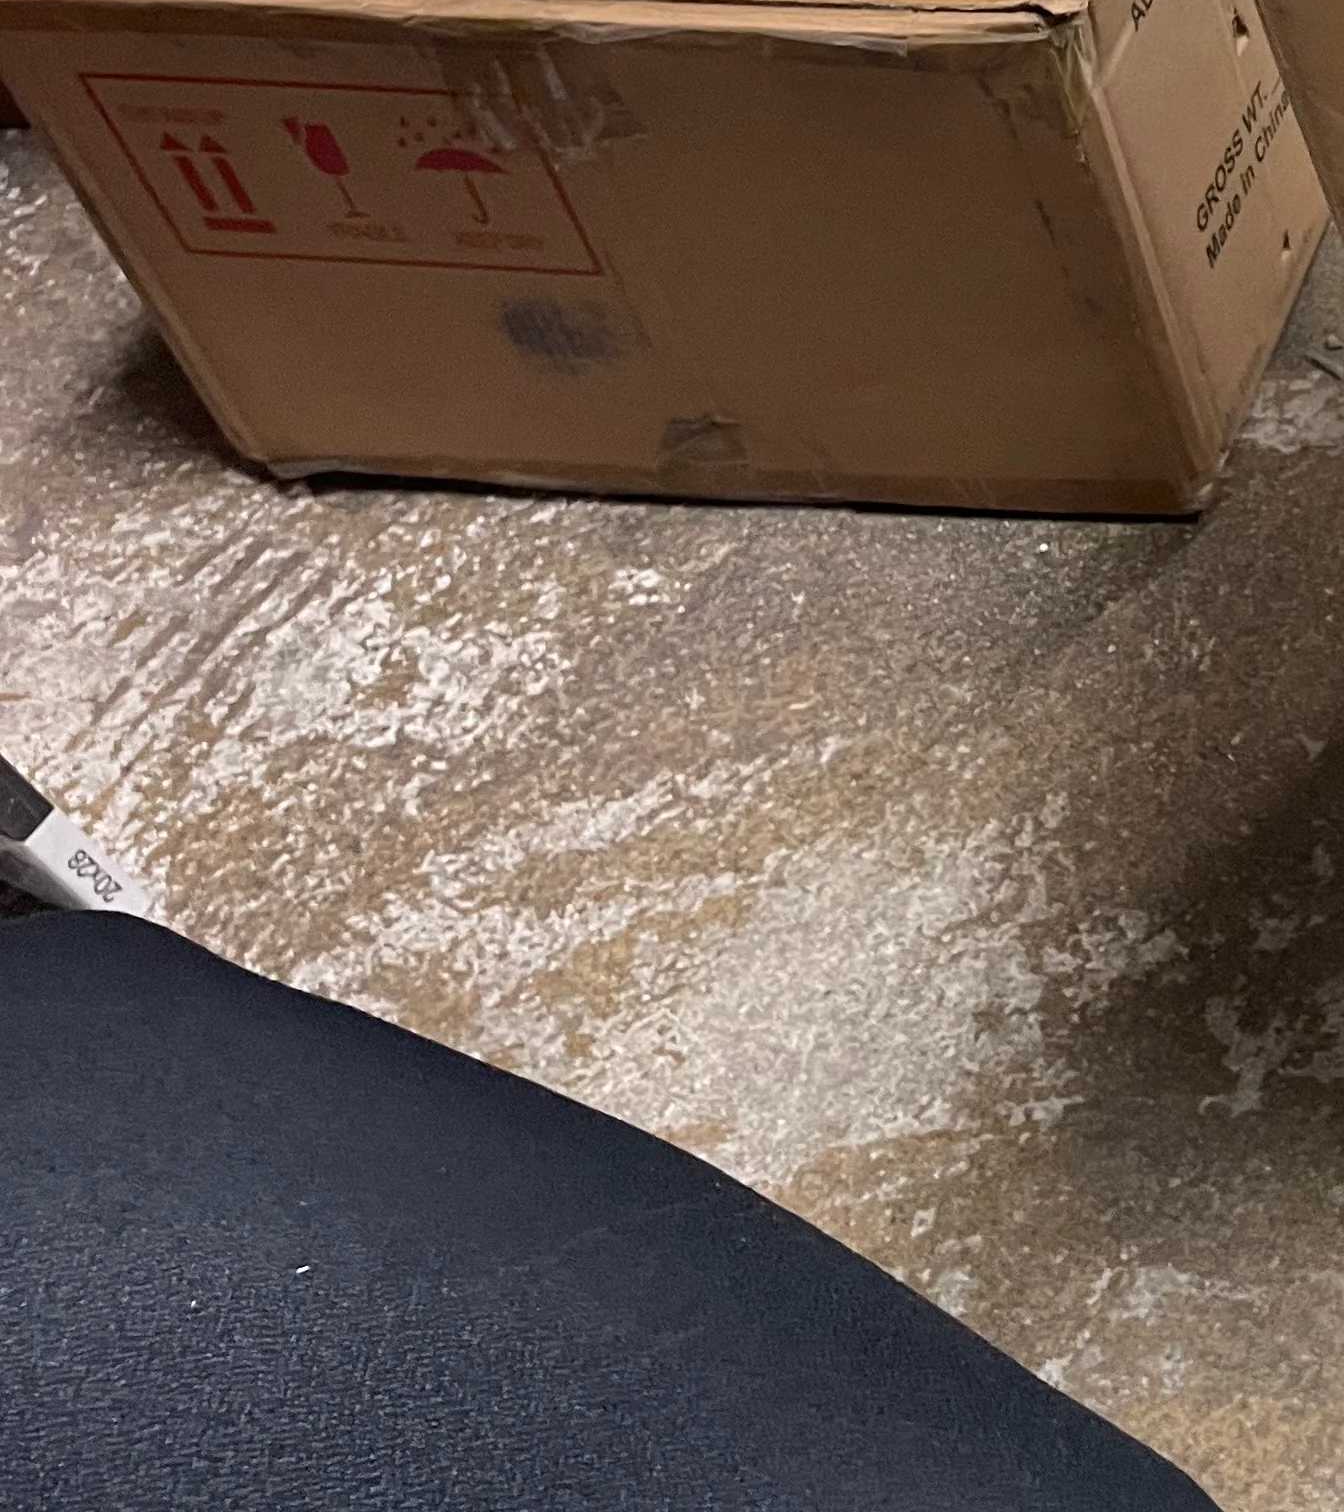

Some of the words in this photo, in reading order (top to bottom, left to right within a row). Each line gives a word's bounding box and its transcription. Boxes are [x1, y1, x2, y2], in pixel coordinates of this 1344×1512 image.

[1197, 129, 1244, 232] GROSS
[1242, 80, 1268, 134] WT.
[1206, 194, 1241, 269] Made
[1240, 165, 1255, 196] in
